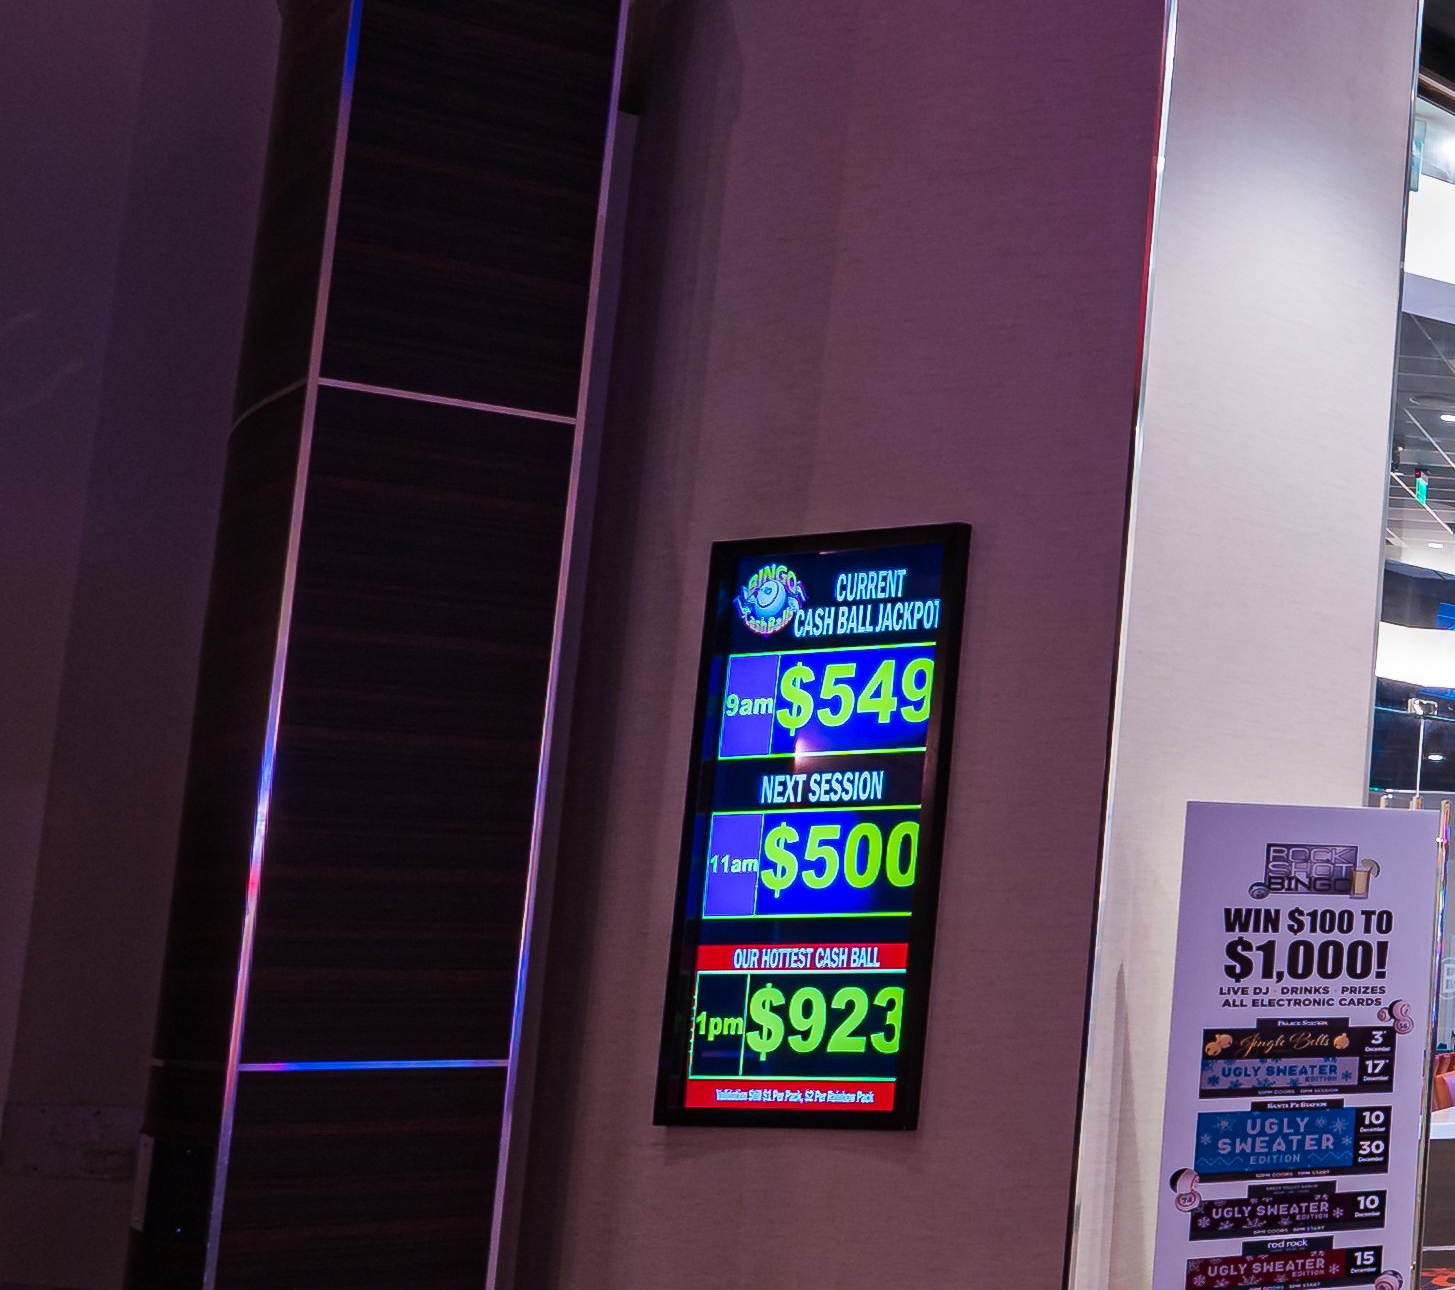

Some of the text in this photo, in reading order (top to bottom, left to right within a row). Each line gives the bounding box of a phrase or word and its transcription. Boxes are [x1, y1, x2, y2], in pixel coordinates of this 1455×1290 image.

[836, 569, 907, 601] CURRENT
[795, 599, 940, 637] CASH BALL JACKPOT
[726, 658, 935, 736] 9am $549
[761, 771, 884, 803] NEXT SESSION
[710, 821, 920, 897] 11am $500
[1270, 847, 1354, 863] ROCK
[1268, 862, 1353, 878] SHOT
[1268, 876, 1351, 892] BINGO
[1224, 907, 1393, 935] WIN $100 TO
[733, 947, 880, 968] OUR HOTTEST CASH BALL
[1224, 937, 1389, 983] $1,000!
[1219, 986, 1386, 996] LIVE DJ DRINKS PRIZES
[1222, 997, 1382, 1007] ALL ELECTRONIC CARDS
[696, 983, 904, 1061] 1pm $923
[1240, 1032, 1329, 1058] Jingle Bells
[1246, 1116, 1310, 1135] UGLY
[1362, 1111, 1385, 1125] 10
[1218, 1133, 1335, 1155] SWEATER
[1358, 1140, 1385, 1155] 30
[1207, 1258, 1325, 1277] UGLY SWEATER
[1354, 1251, 1375, 1265] 15
